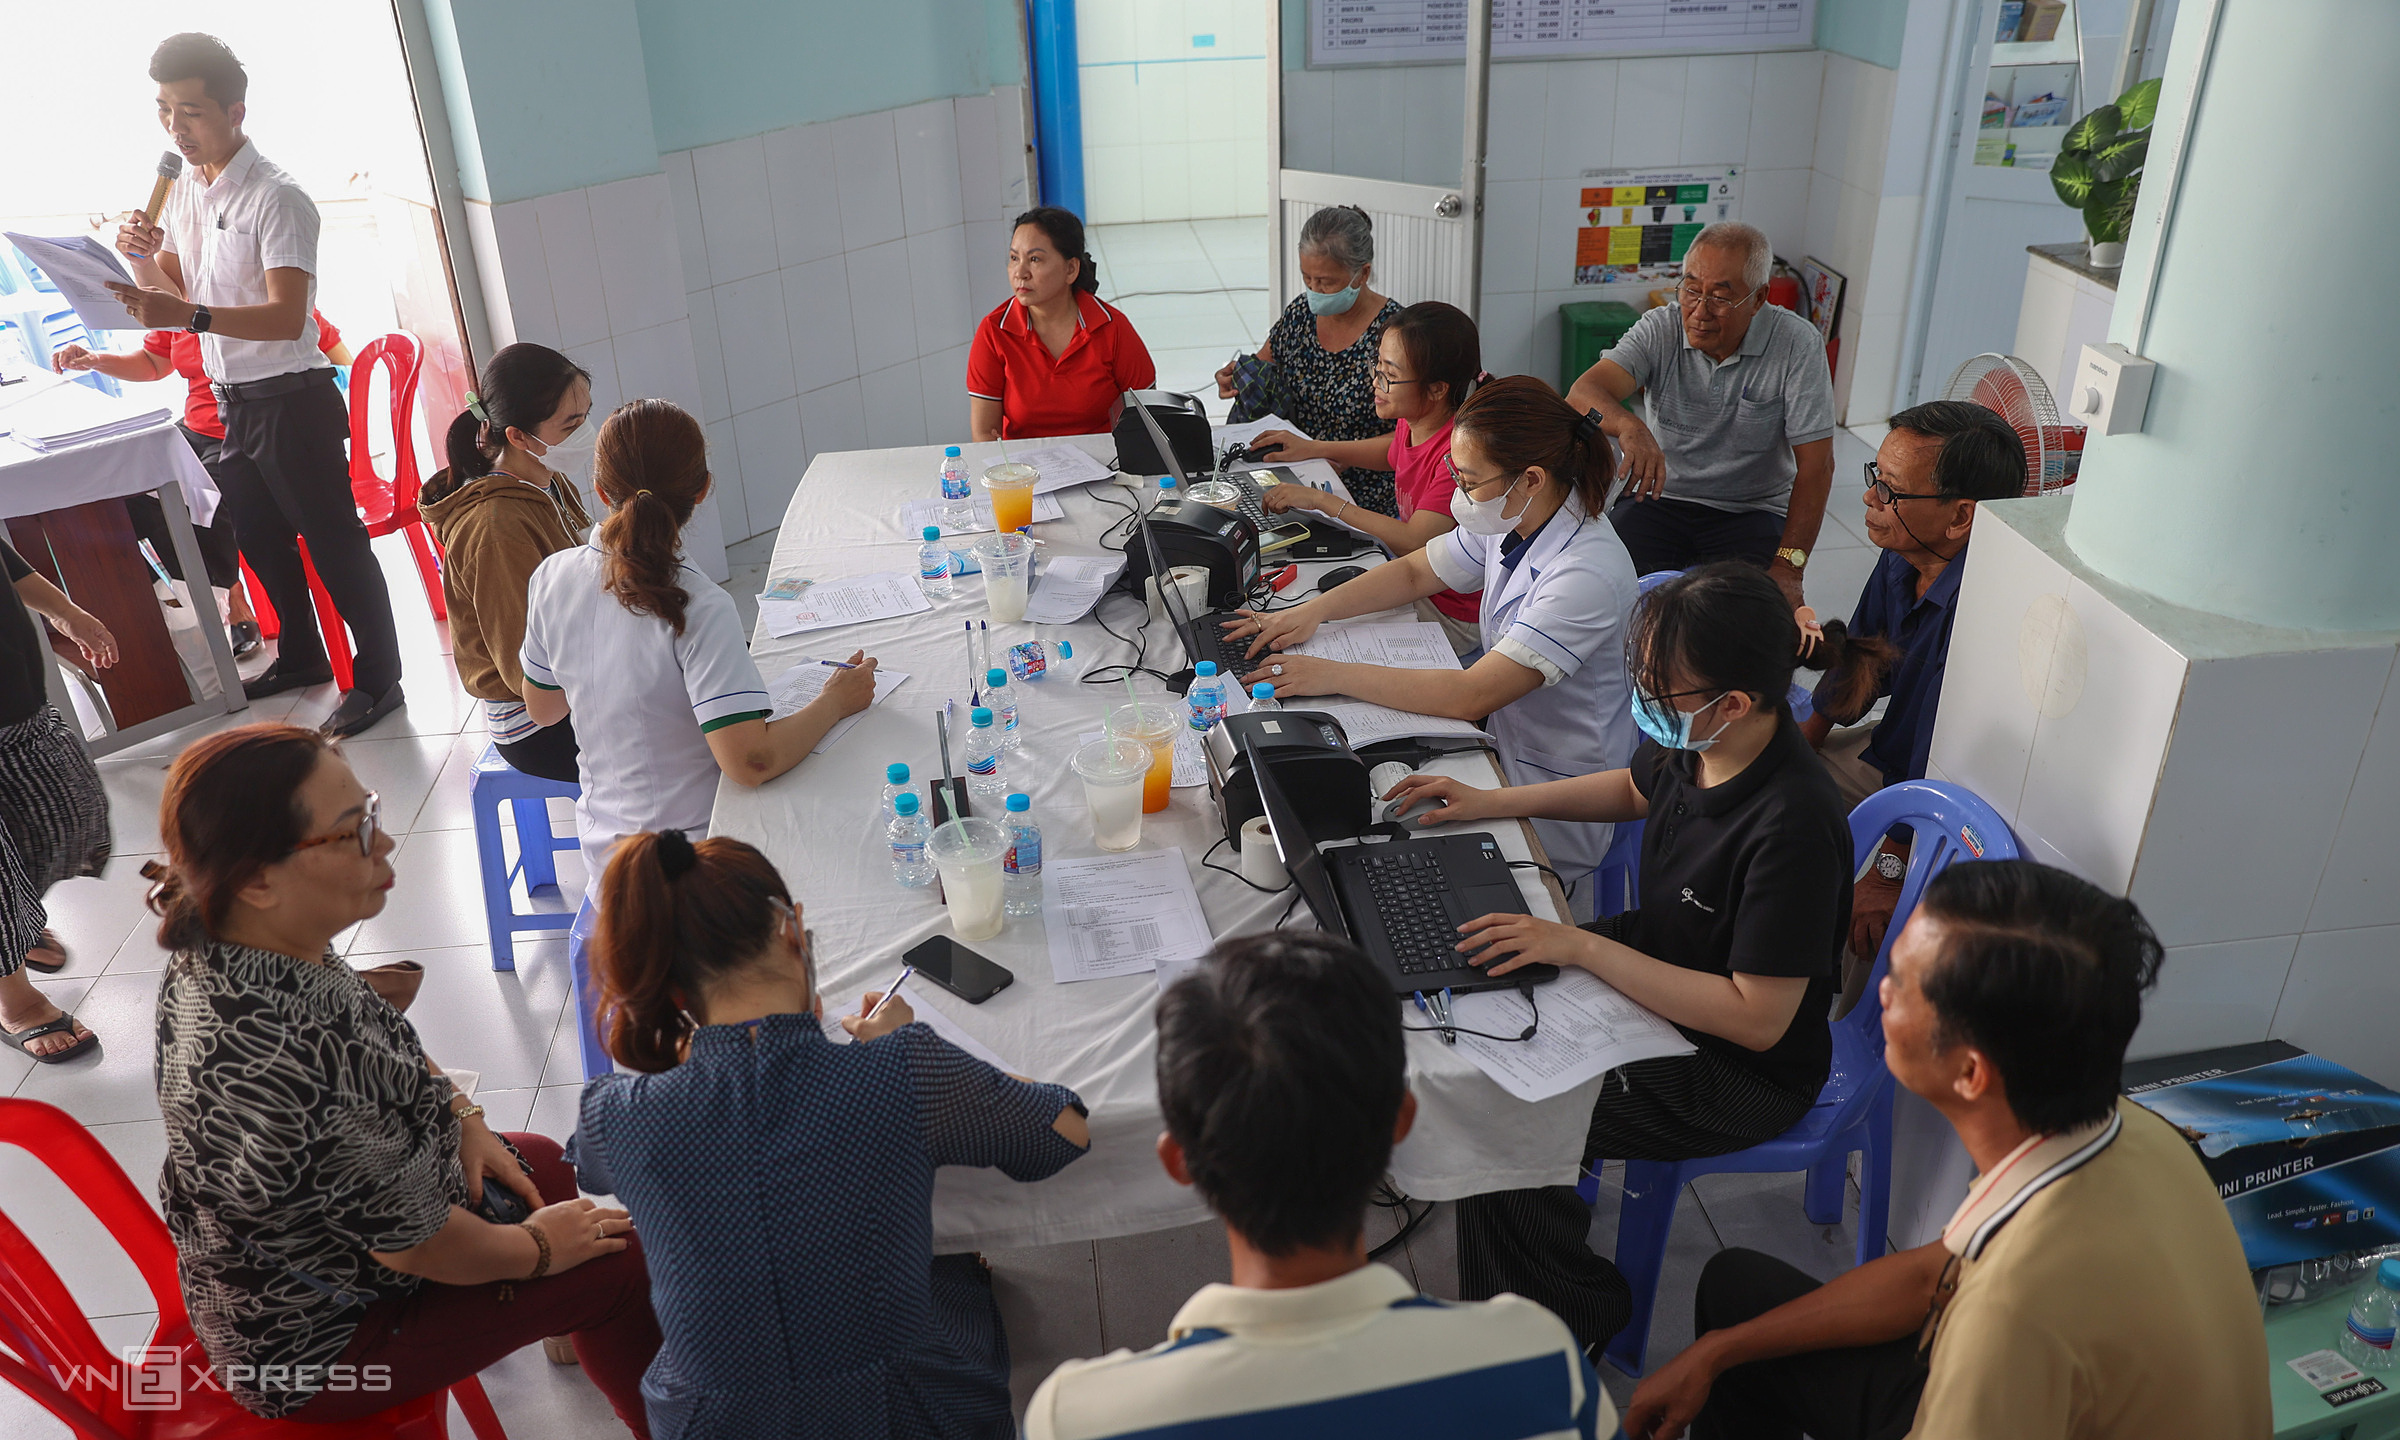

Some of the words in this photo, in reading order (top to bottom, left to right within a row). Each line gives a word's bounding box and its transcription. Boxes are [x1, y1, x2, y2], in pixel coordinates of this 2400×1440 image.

[2129, 1081, 2163, 1094] MINI
[2164, 1068, 2226, 1087] PRINTER
[2218, 1179, 2240, 1197] INI
[2245, 1156, 2314, 1188] PRINTER
